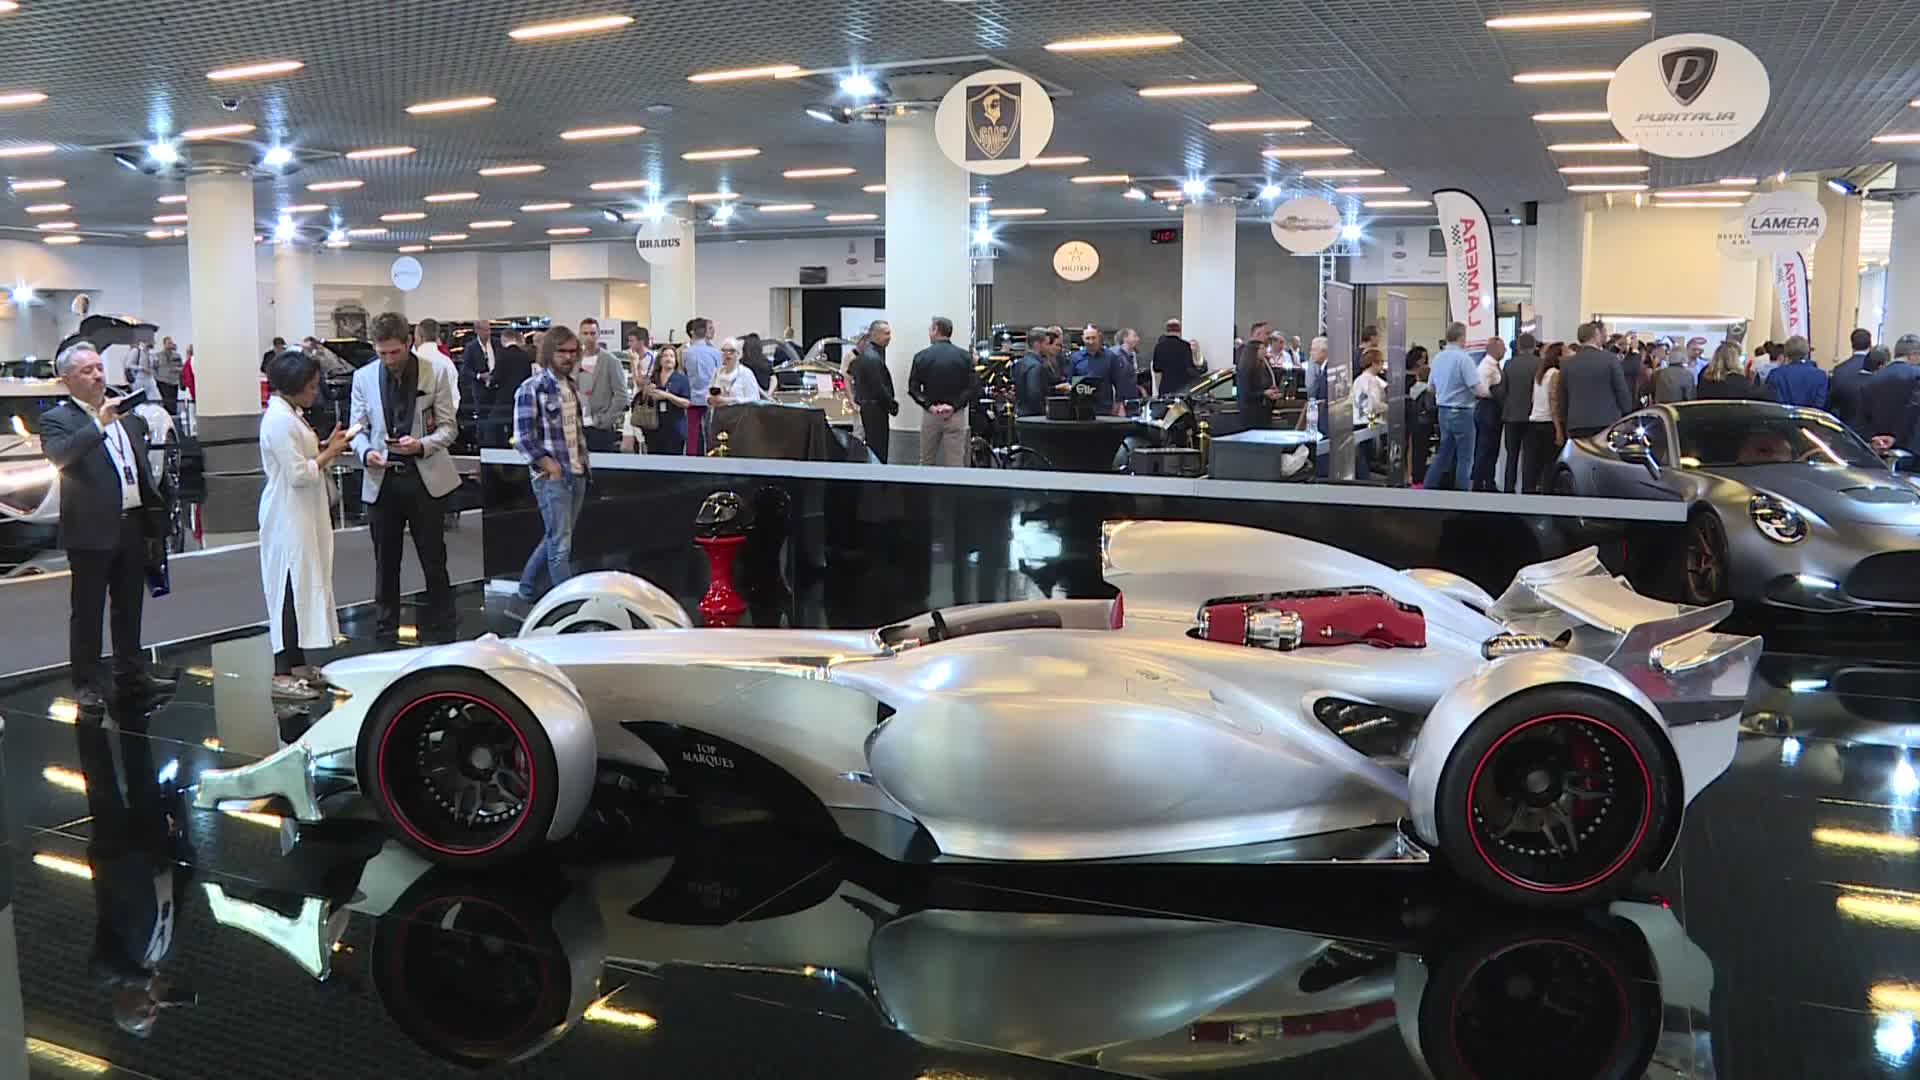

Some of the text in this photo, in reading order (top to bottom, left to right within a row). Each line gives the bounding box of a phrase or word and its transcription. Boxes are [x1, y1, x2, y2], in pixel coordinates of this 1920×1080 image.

[1635, 112, 1736, 122] PURITALIA
[1751, 216, 1820, 229] LAMERA
[639, 238, 681, 248] BRABUS
[696, 743, 717, 755] TOP
[682, 751, 735, 768] MARQUES
